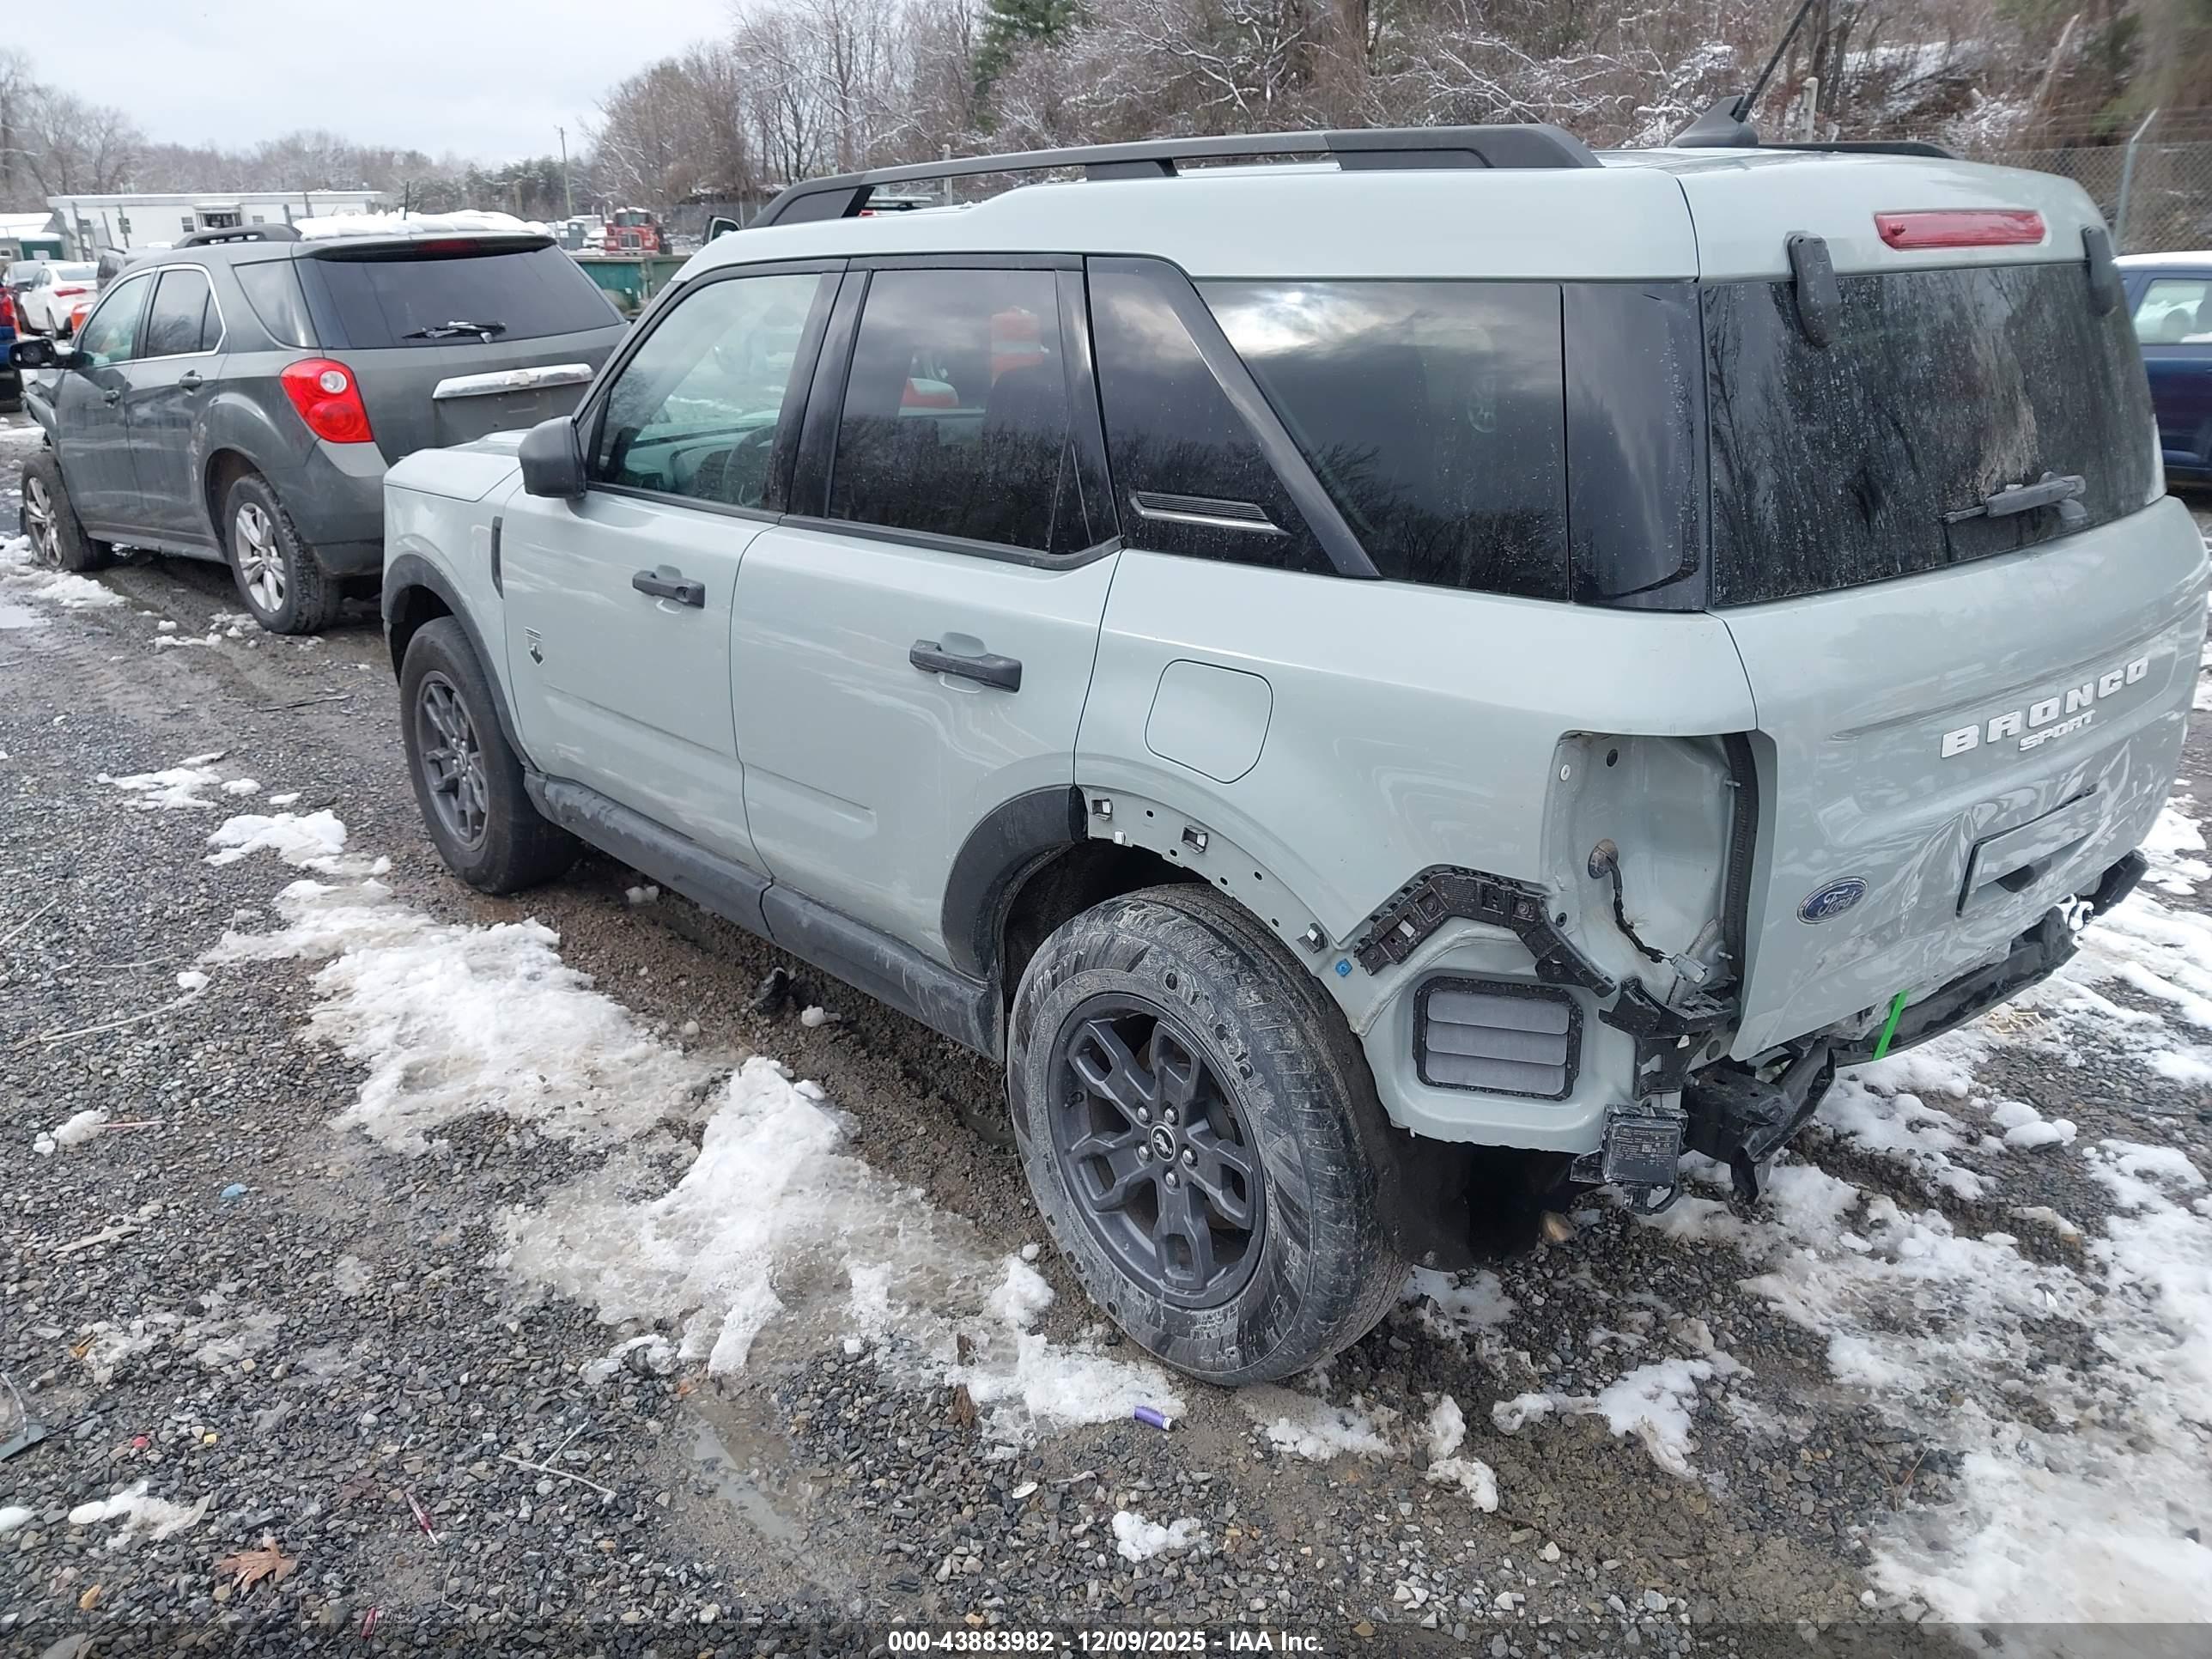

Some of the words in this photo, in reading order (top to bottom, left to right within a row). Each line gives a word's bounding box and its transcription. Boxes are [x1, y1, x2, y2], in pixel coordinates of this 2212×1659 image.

[1941, 656, 2149, 758] BRONCO
[2019, 709, 2095, 752] SPORT
[1818, 888, 1858, 916] Ford
